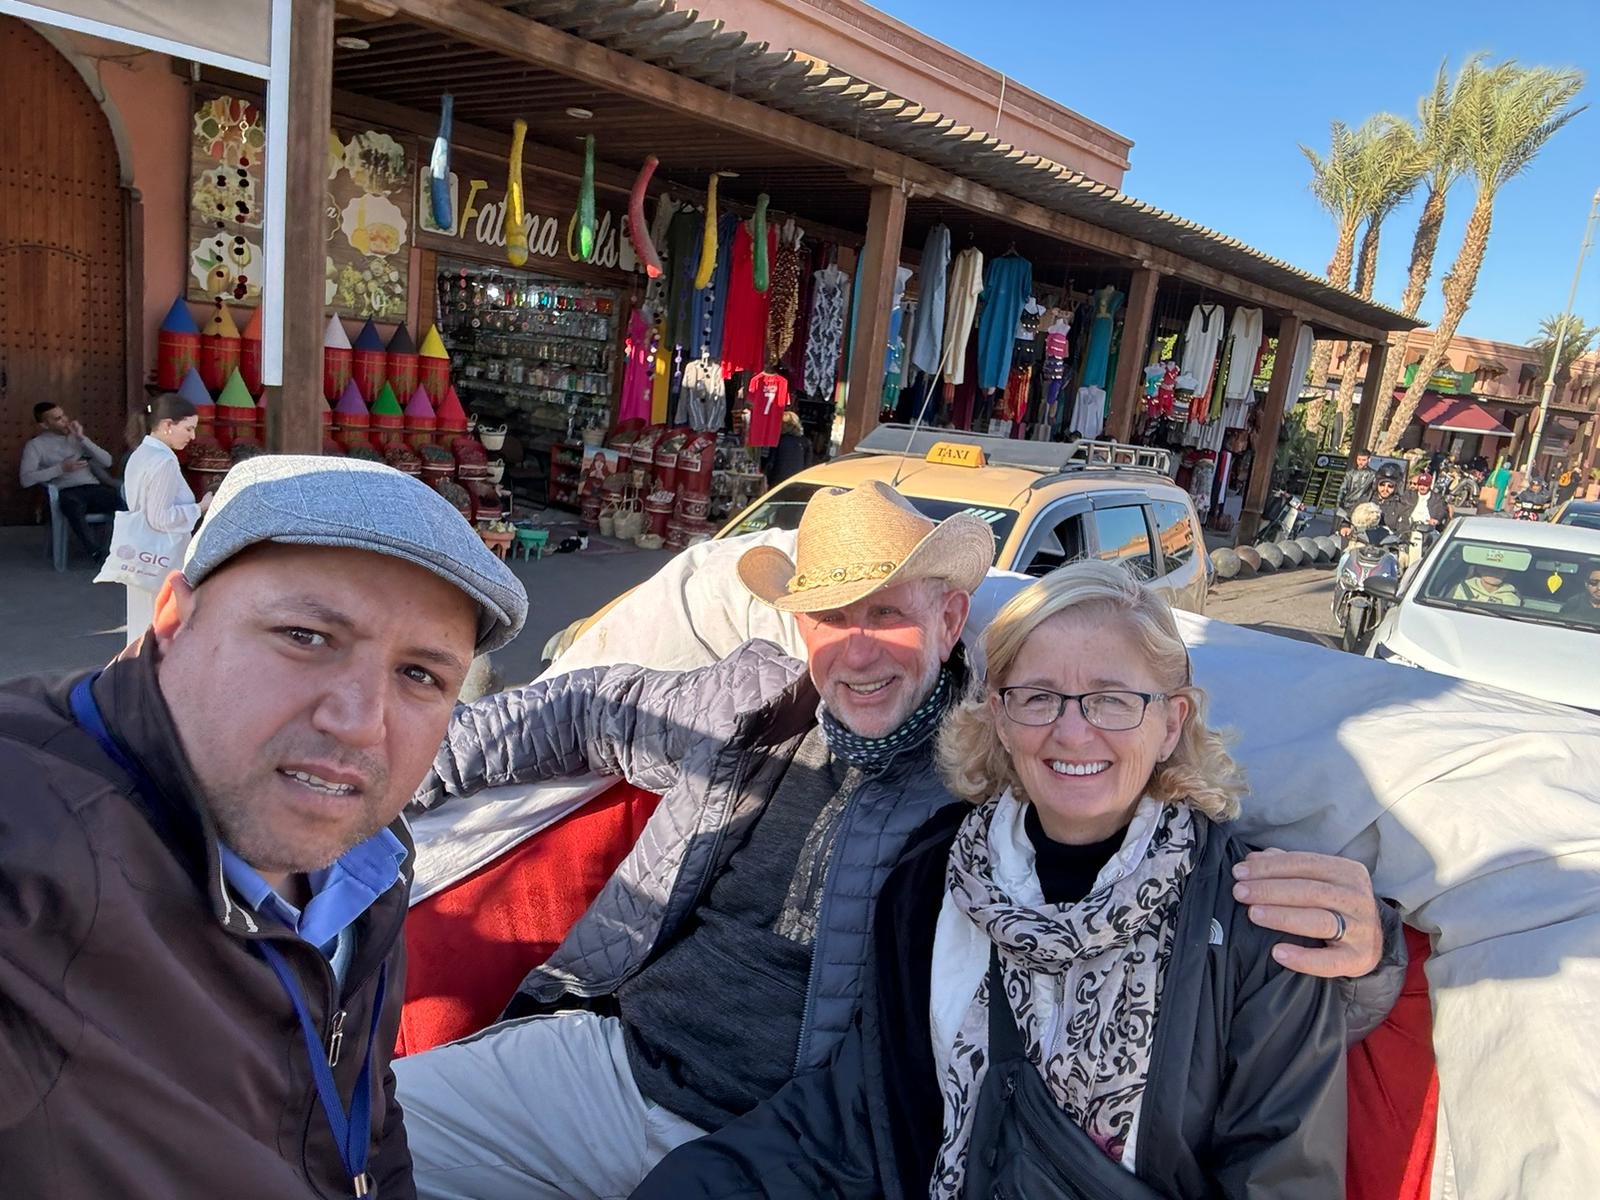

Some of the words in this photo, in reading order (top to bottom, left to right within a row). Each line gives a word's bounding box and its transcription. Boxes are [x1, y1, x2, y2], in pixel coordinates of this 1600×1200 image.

[460, 180, 559, 257] Fatma
[763, 392, 776, 415] 7
[937, 447, 970, 460] TAXI
[138, 551, 170, 568] GIC
